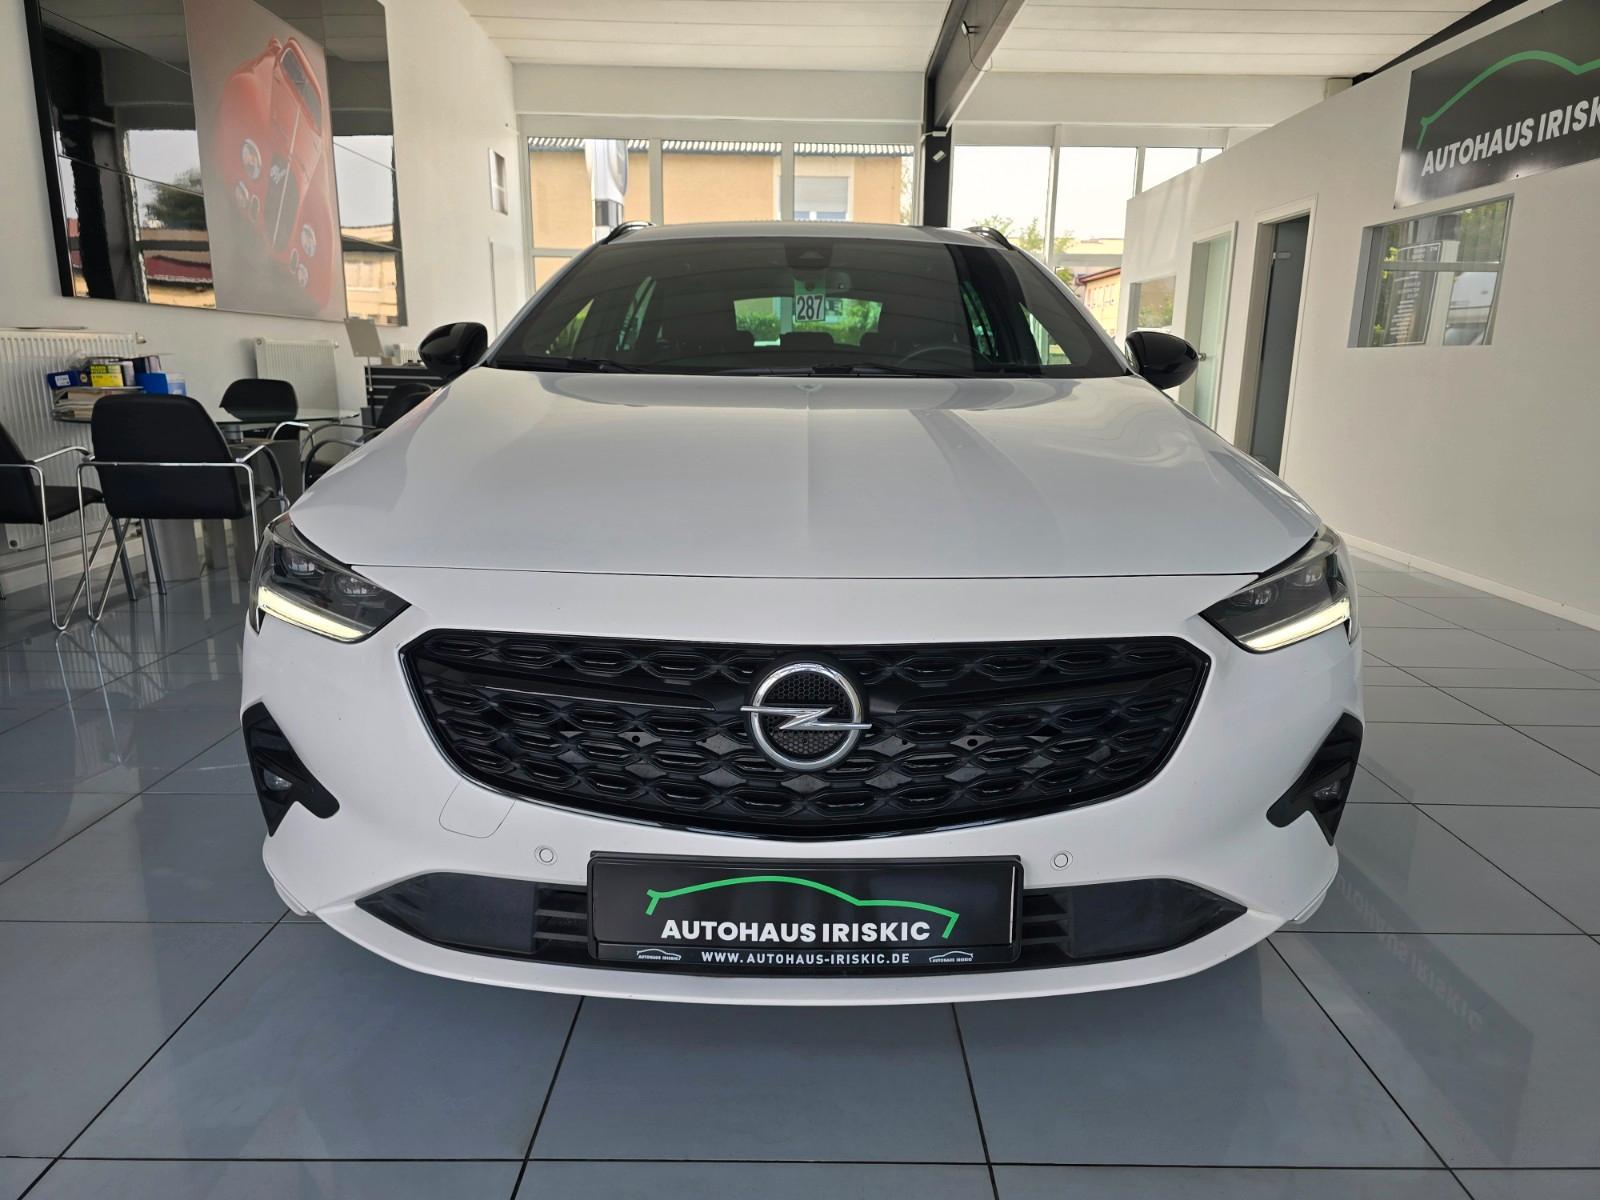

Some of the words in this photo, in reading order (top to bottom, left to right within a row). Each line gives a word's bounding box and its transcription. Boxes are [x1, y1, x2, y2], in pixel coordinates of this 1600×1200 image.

[1421, 117, 1534, 177] AUTOHAUS
[797, 295, 823, 320] 287
[661, 919, 816, 943] AUTOHAUS
[822, 921, 931, 943] IRISKIC
